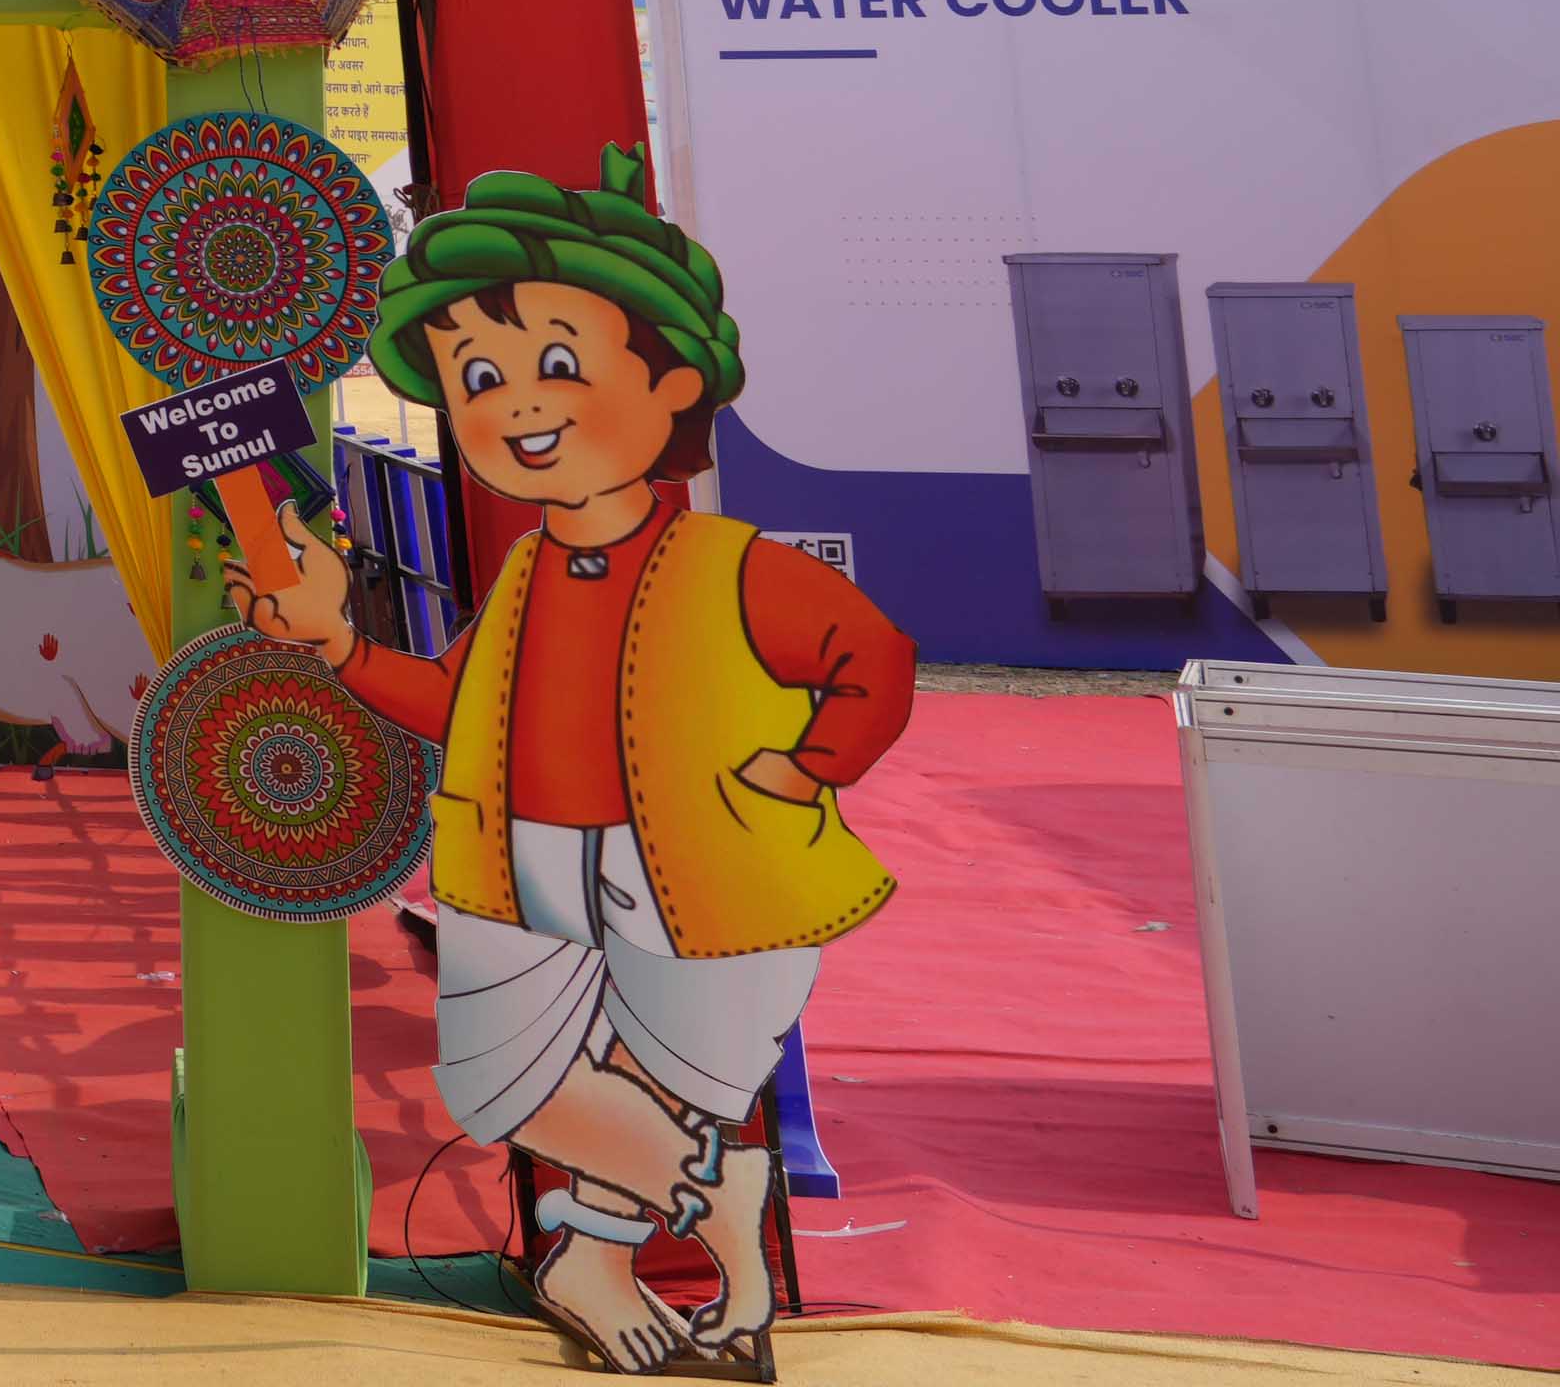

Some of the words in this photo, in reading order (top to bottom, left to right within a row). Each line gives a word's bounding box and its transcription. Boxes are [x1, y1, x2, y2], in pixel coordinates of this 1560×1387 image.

[139, 377, 277, 435] Welcome
[182, 430, 276, 478] Sumul
[199, 421, 239, 445] To
